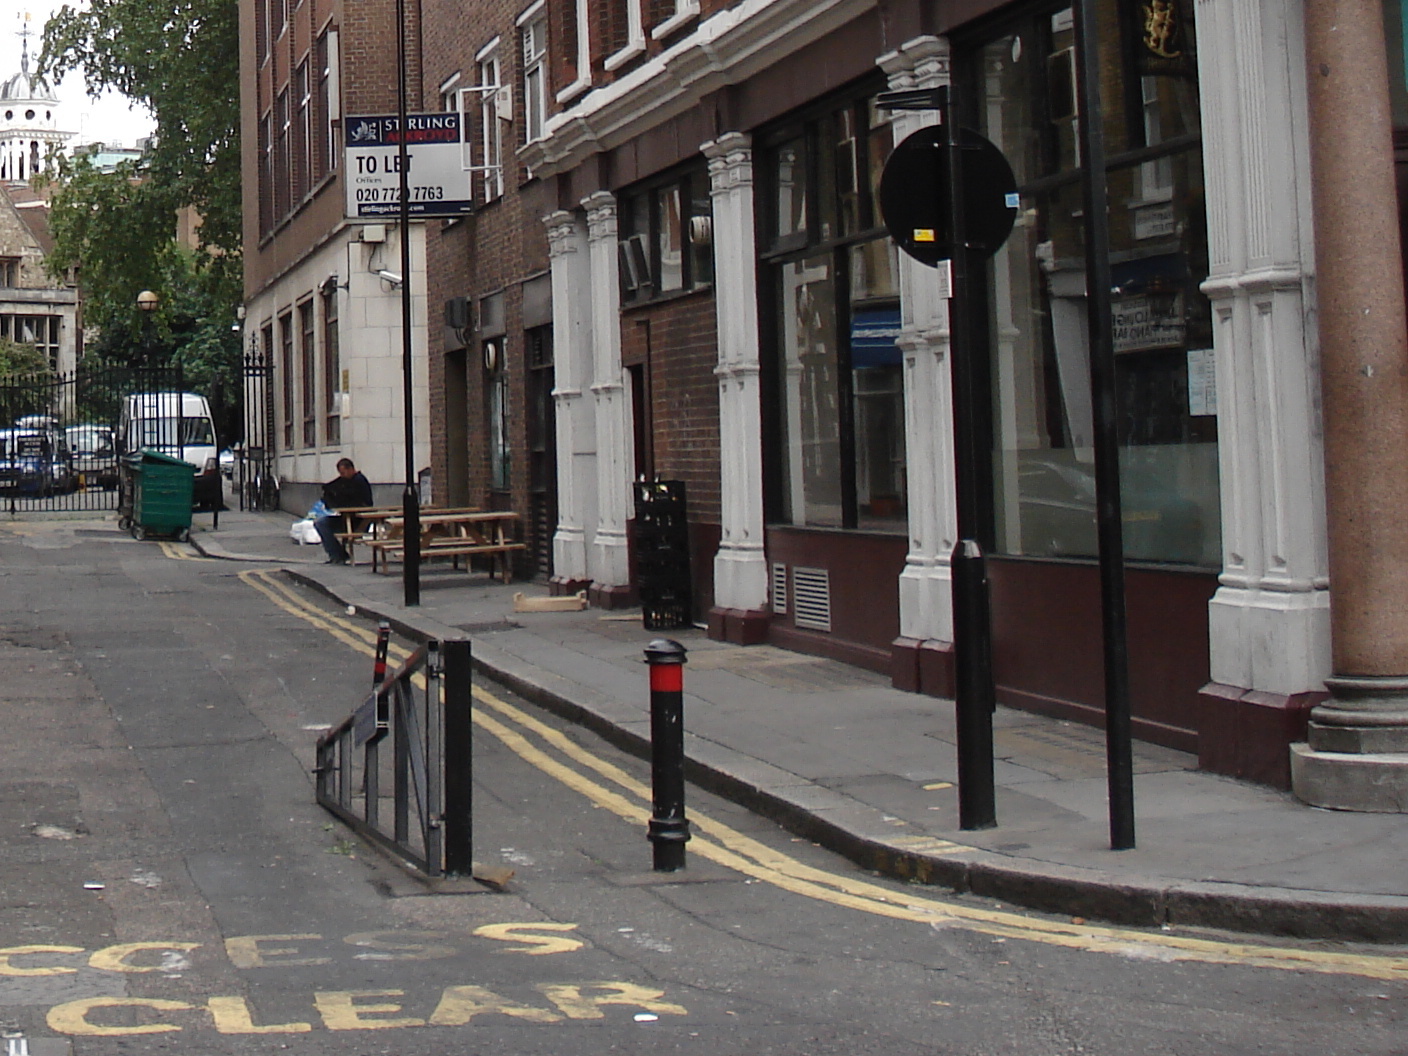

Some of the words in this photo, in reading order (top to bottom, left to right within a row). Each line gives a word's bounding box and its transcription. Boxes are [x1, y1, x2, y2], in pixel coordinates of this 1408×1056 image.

[385, 117, 456, 131] STRLING
[356, 155, 377, 174] TO
[356, 188, 379, 202] 020
[413, 186, 444, 201] 7763
[45, 980, 688, 1037] CLEAR
